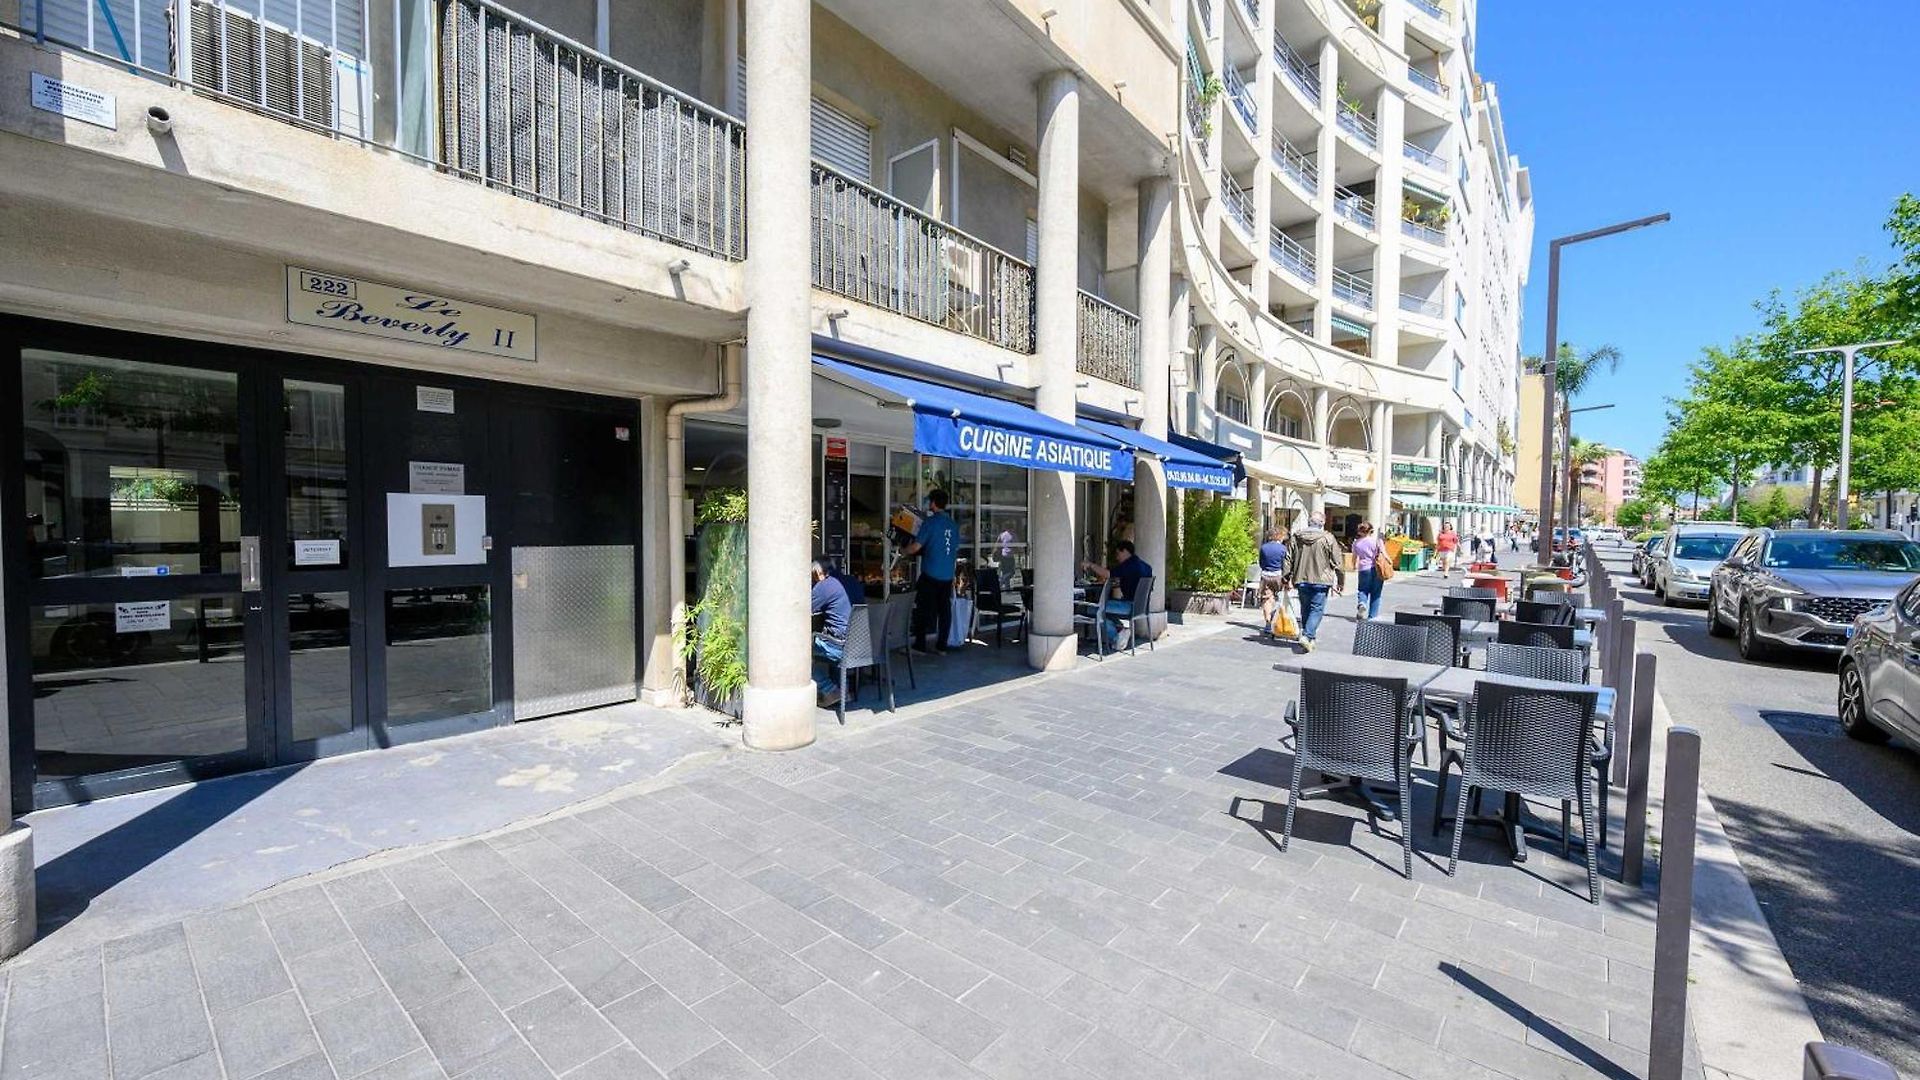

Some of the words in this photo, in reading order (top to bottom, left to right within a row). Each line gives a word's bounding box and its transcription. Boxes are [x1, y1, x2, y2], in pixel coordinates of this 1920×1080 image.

[310, 277, 348, 296] 222
[396, 295, 462, 318] Le
[316, 300, 470, 347] Beverly
[493, 328, 516, 349] II
[959, 425, 1033, 460] CUISINE
[1036, 440, 1112, 471] ASIATIQUE
